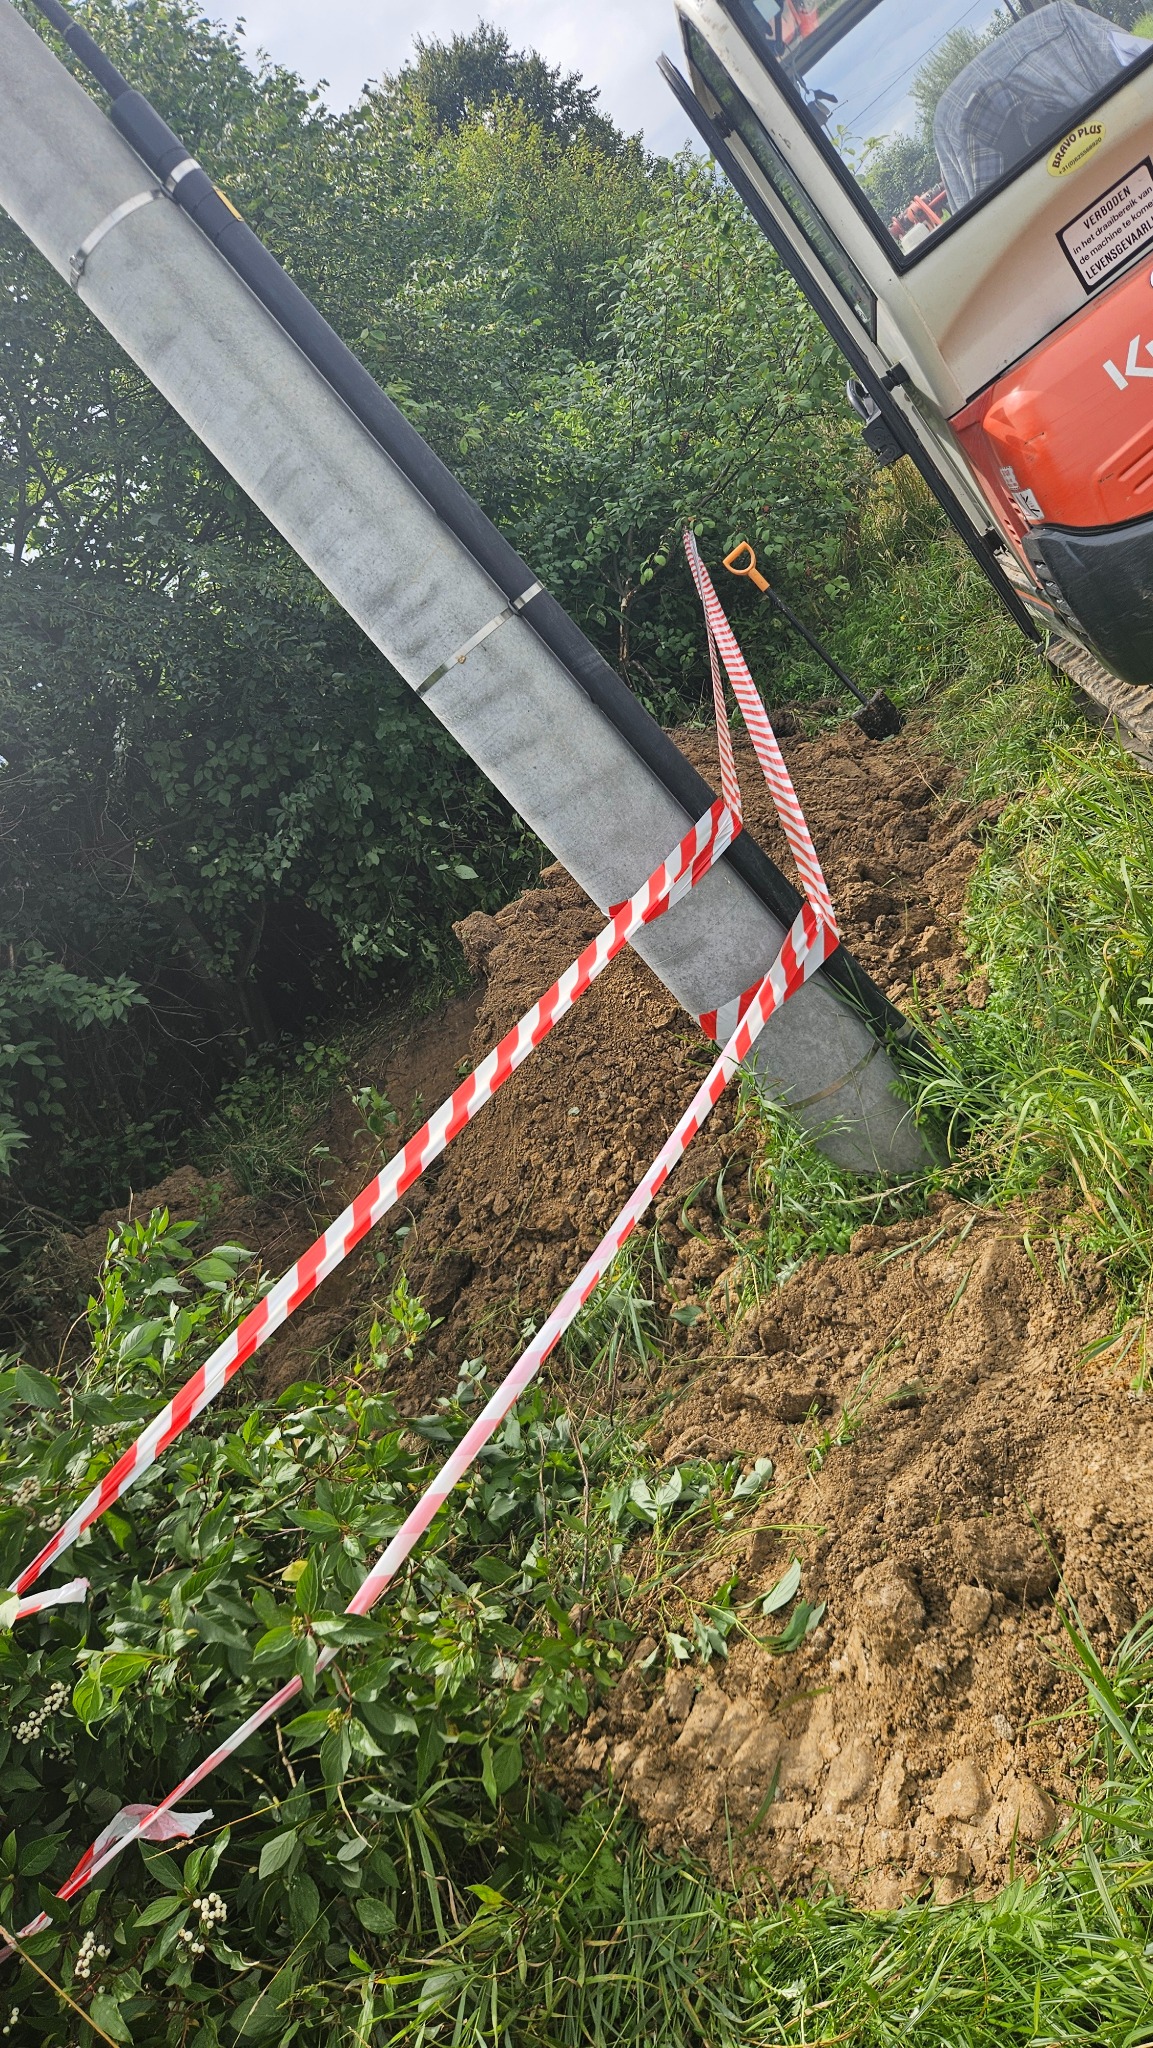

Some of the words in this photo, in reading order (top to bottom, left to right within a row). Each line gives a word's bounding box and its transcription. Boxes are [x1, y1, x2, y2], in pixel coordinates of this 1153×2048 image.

[1052, 133, 1077, 168] BRAVO
[1077, 125, 1102, 138] PLUS
[1072, 246, 1082, 255] in
[1081, 234, 1096, 249] het
[1095, 198, 1138, 236] draaibereik
[1138, 186, 1153, 200] van
[1079, 254, 1090, 265] de
[1090, 227, 1123, 257] machine
[1122, 219, 1132, 229] te
[1131, 199, 1153, 221] kome
[1083, 185, 1131, 229] VERBODEN
